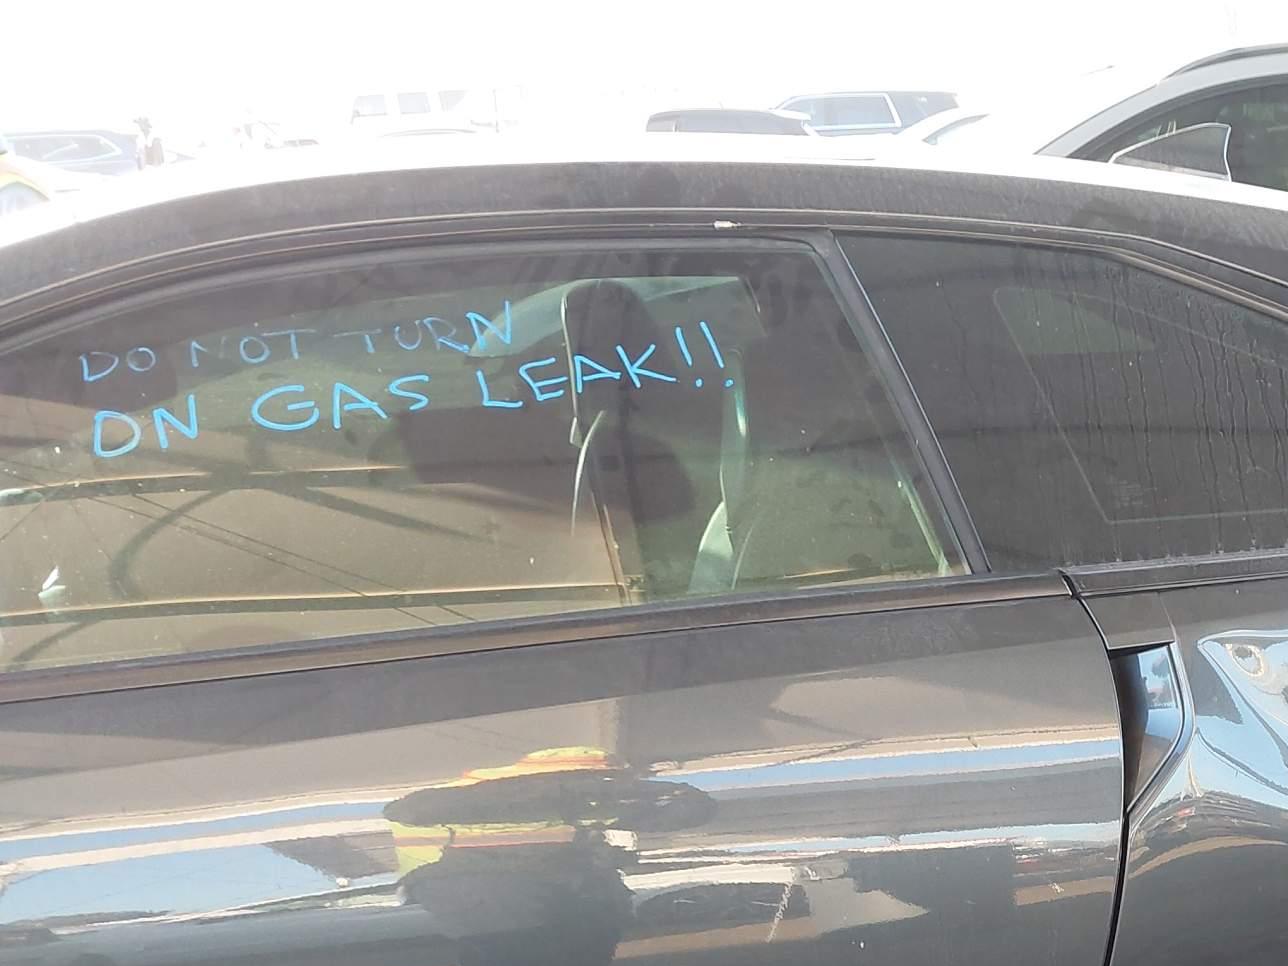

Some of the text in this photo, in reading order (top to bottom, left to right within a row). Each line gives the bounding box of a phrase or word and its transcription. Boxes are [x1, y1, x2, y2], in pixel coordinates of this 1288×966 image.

[80, 300, 512, 382] DO NOT TURN
[251, 374, 430, 430] GAS
[475, 321, 734, 407] LEAK!!
